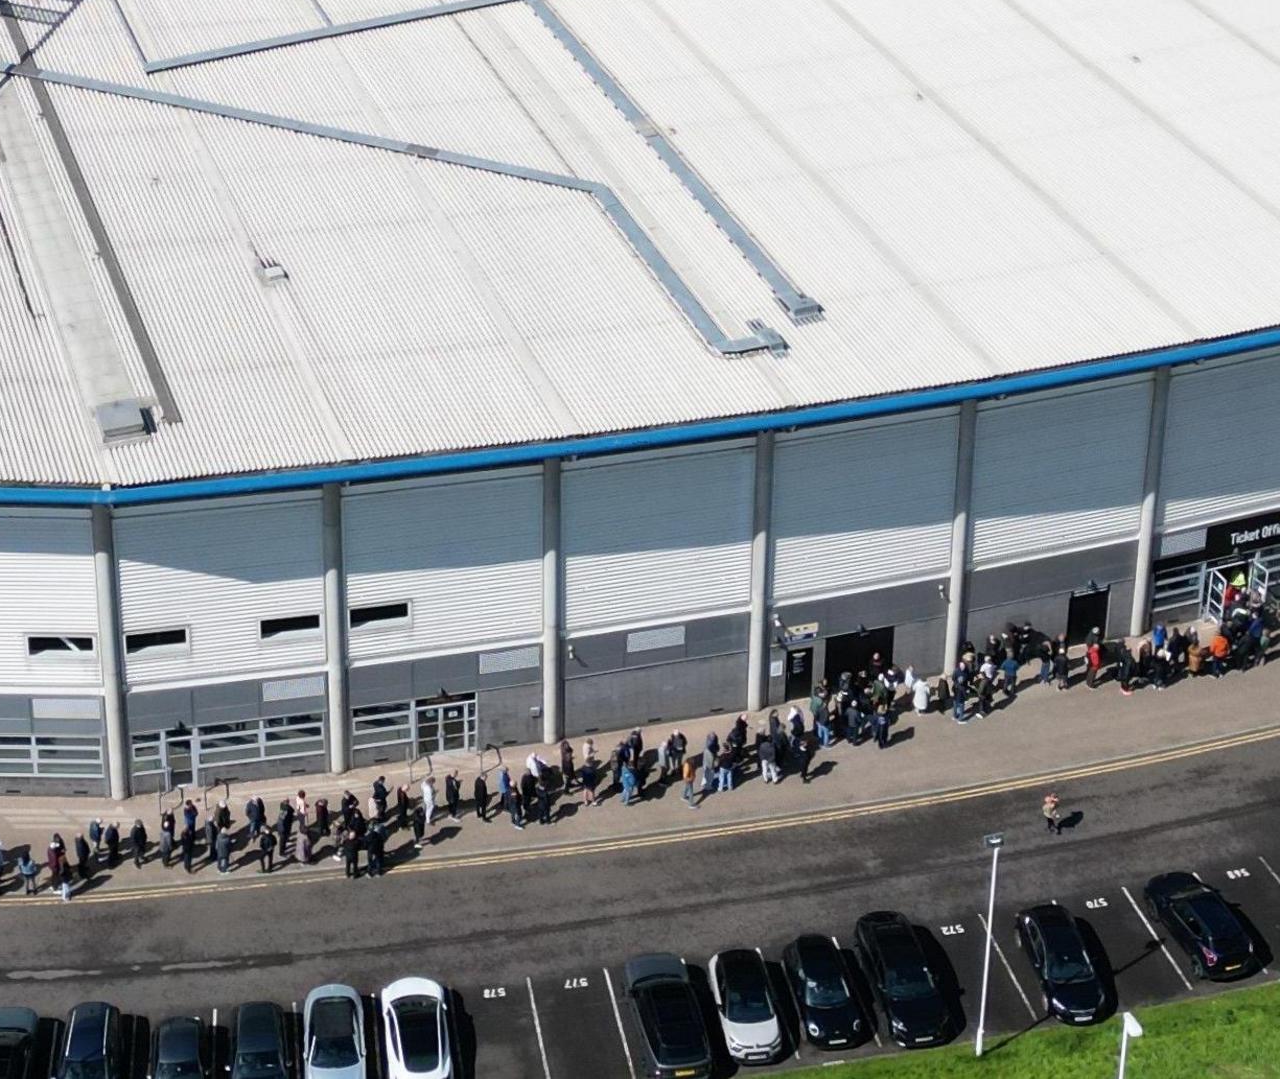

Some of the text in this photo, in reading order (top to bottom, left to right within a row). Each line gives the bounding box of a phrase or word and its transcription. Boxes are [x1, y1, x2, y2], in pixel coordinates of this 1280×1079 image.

[1230, 529, 1260, 546] Ticket
[1085, 897, 1108, 909] 570
[940, 924, 965, 935] 572
[564, 977, 588, 989] 577
[483, 987, 506, 999] 578
